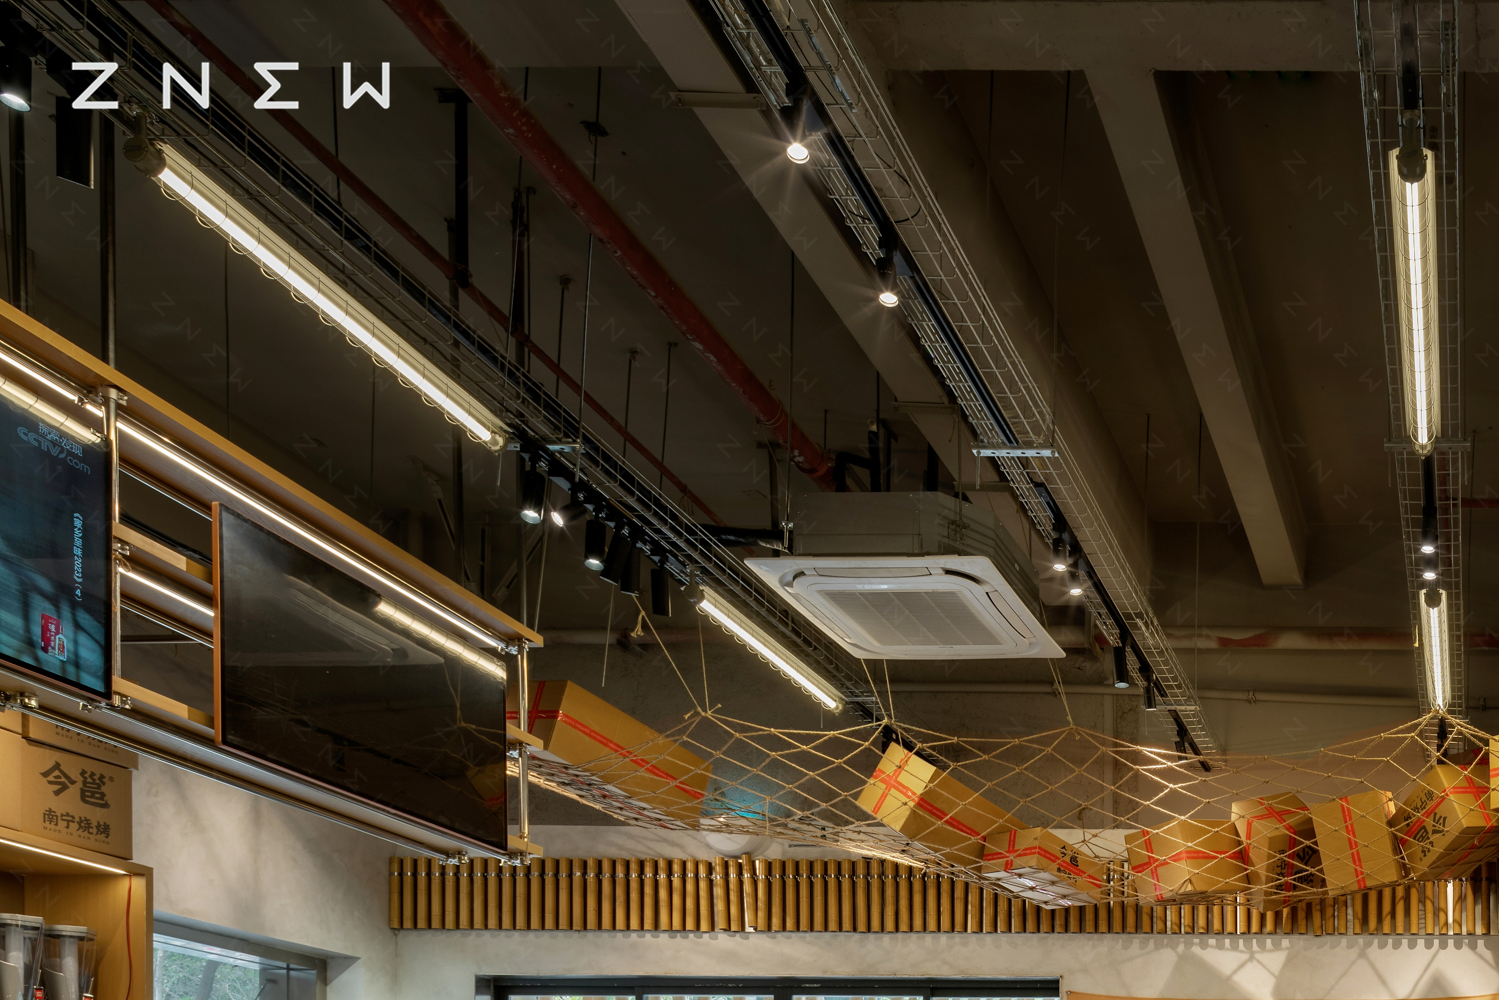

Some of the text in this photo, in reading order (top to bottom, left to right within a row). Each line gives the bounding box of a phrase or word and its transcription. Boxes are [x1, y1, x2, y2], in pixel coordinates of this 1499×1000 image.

[39, 760, 111, 809] 今邕
[42, 807, 112, 840] 南宁烧烤
